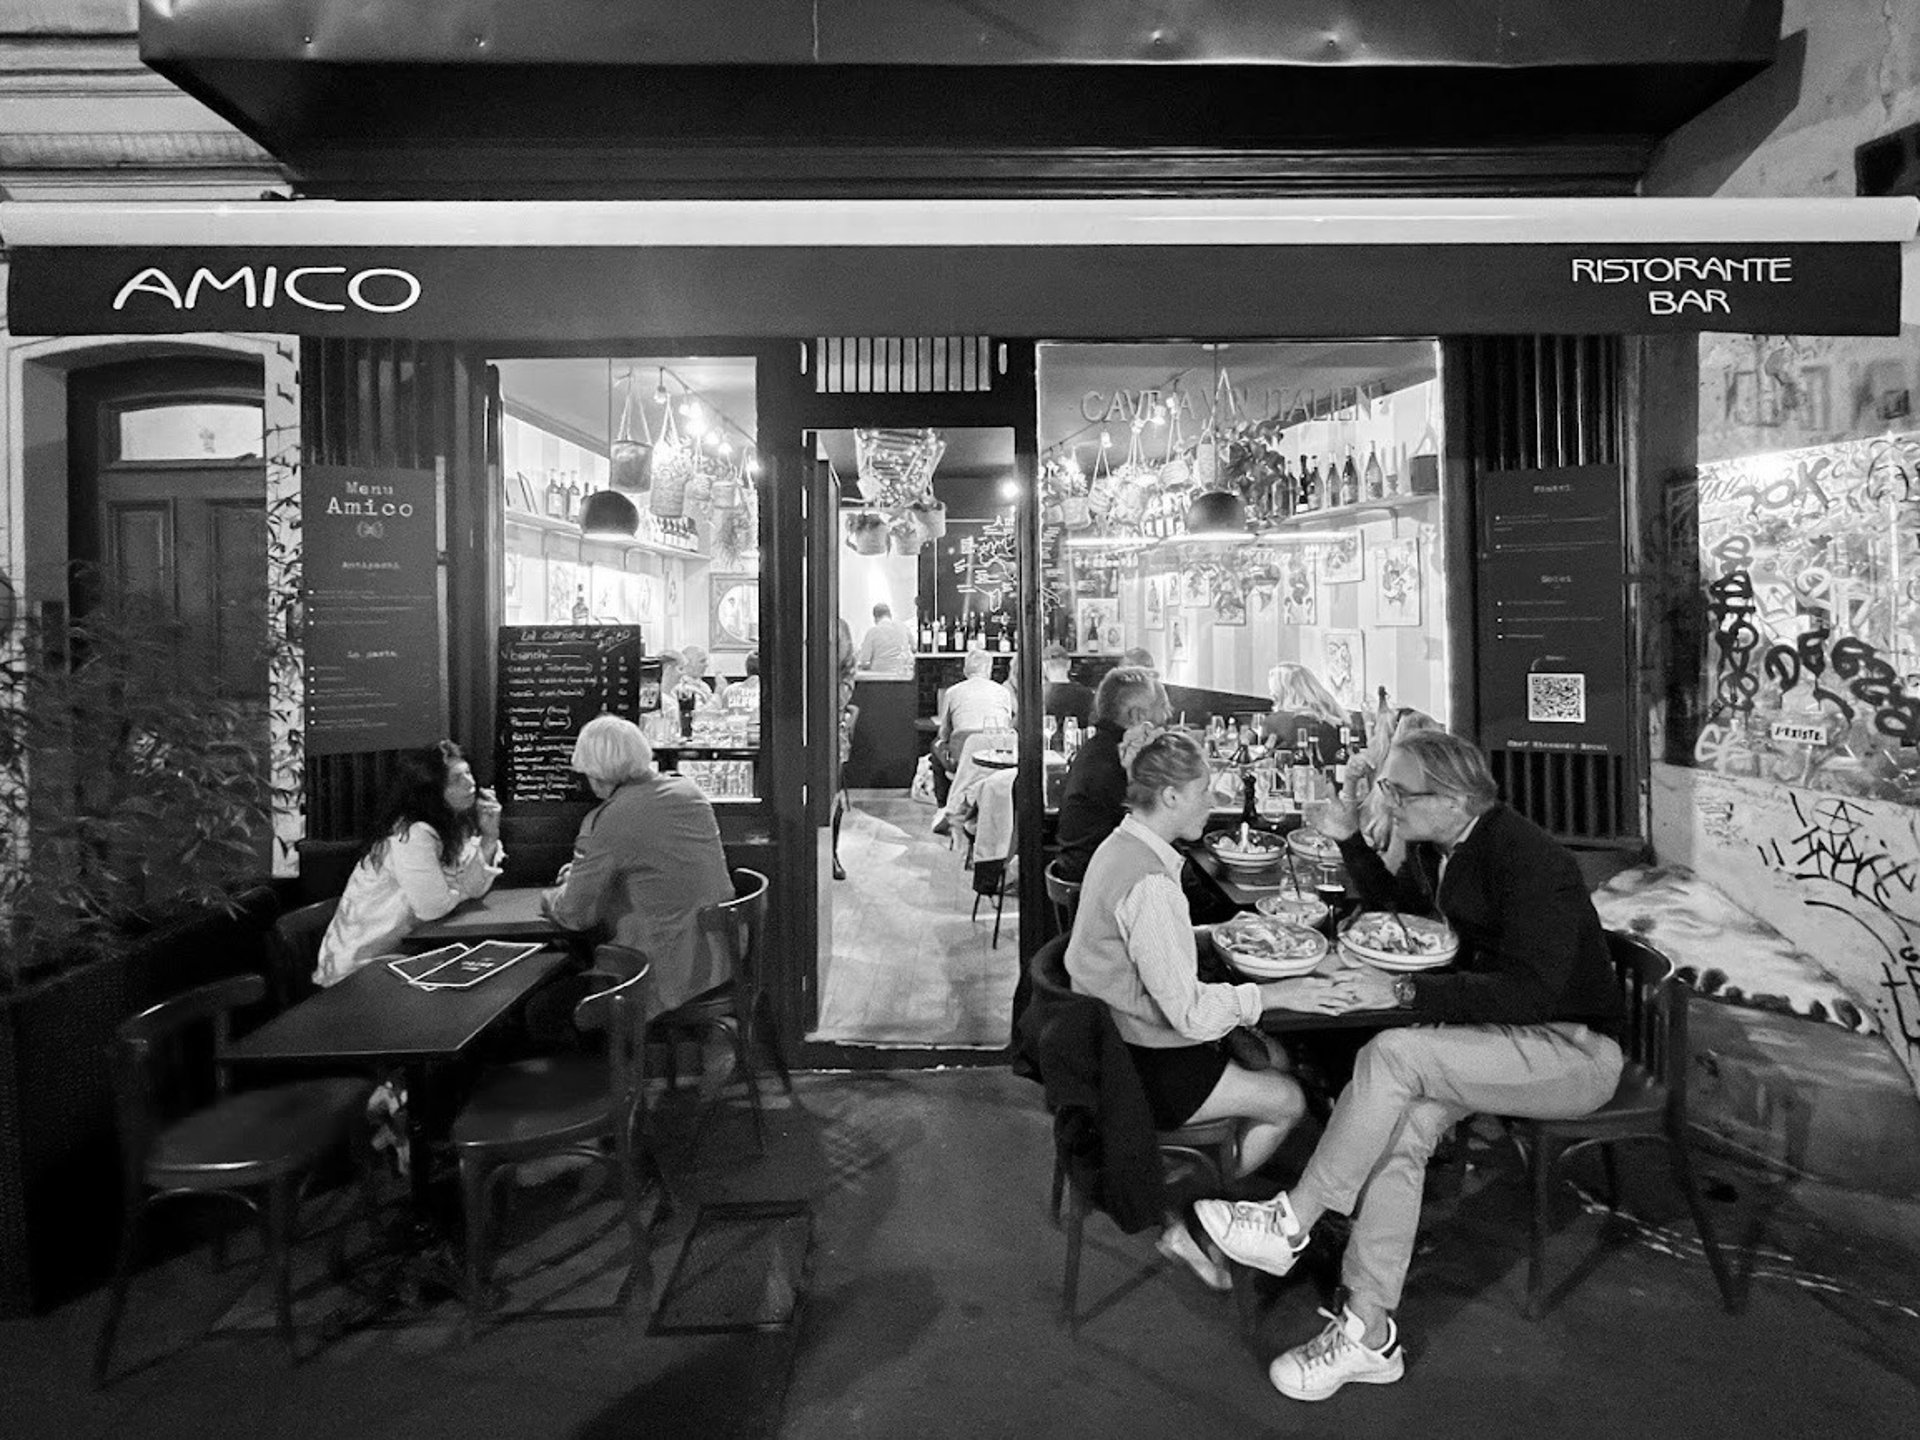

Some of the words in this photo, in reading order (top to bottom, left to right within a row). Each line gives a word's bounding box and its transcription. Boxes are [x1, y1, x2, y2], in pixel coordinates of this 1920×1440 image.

[1571, 256, 1793, 283] RISTORANTE
[113, 266, 422, 313] AMICO
[1648, 288, 1731, 315] BAR
[1080, 389, 1162, 423] CAVE
[1265, 385, 1373, 422] ITALIEN
[345, 481, 394, 495] Menu
[325, 496, 414, 518] Amico
